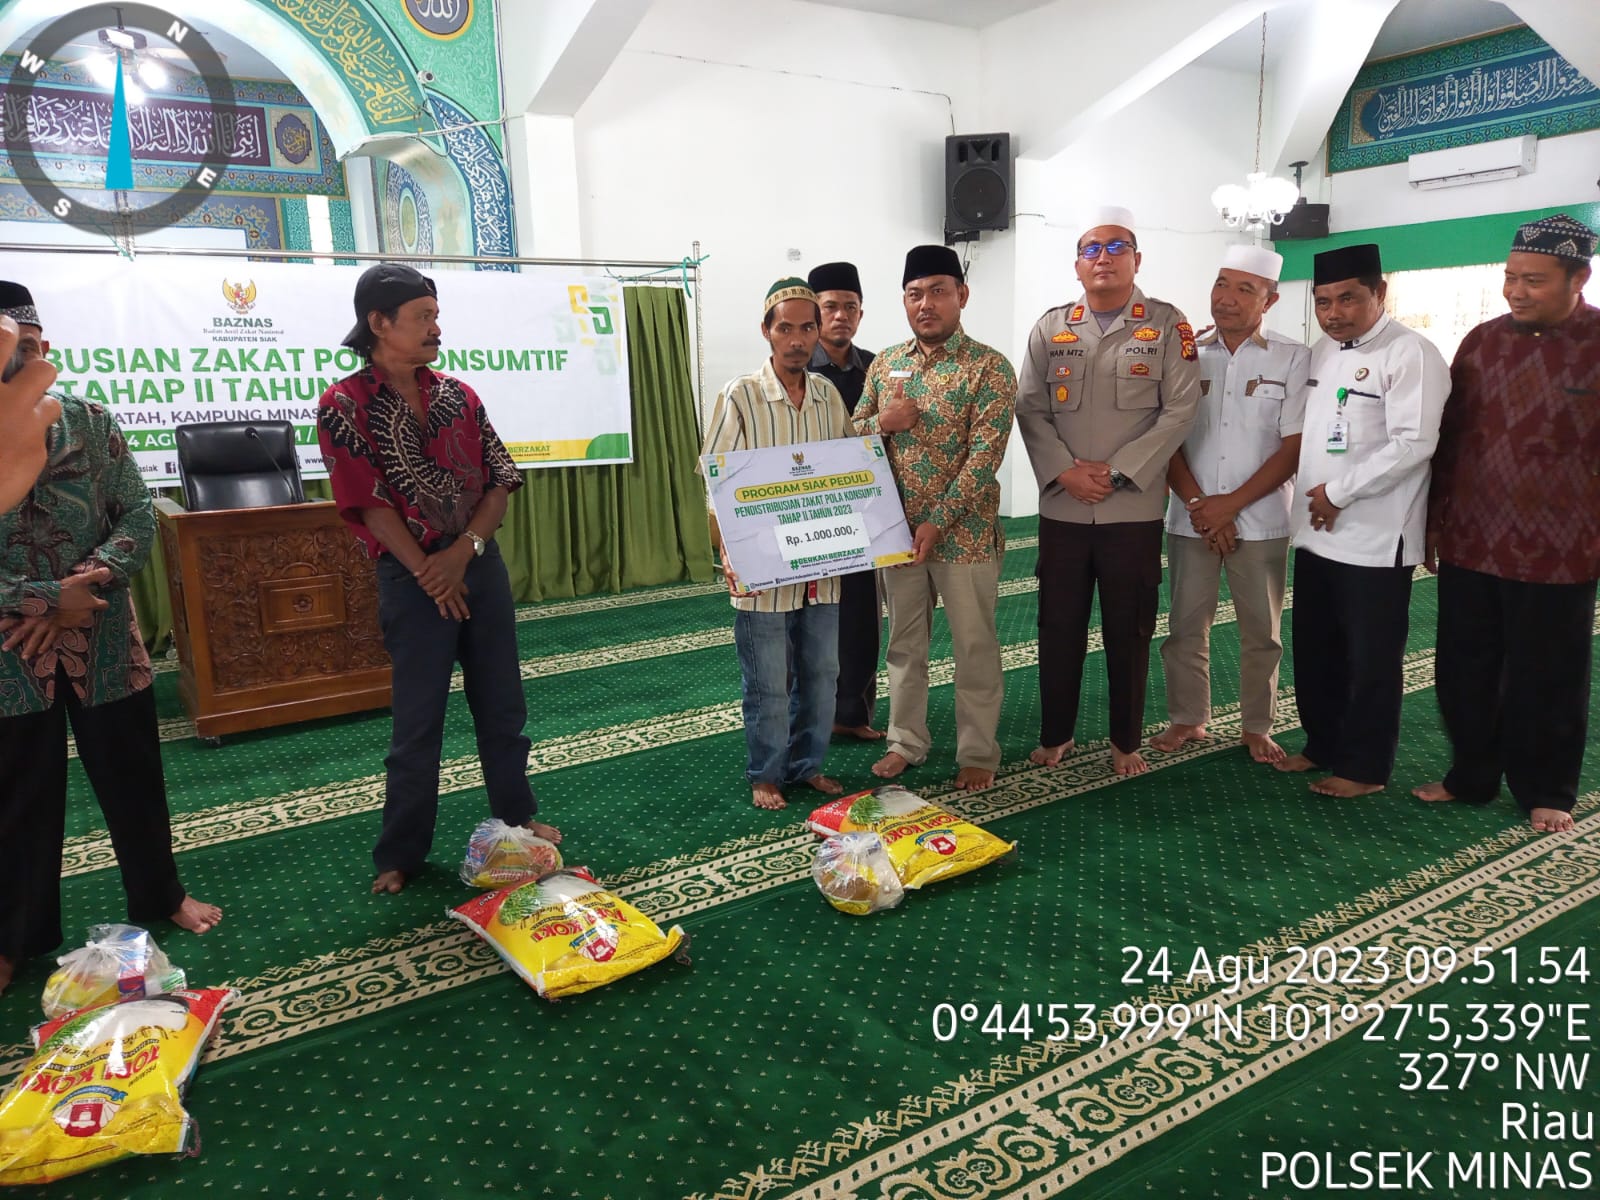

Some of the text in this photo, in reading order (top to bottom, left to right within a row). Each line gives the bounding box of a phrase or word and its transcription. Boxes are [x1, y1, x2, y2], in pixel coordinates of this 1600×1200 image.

[212, 317, 273, 328] BAZNAS
[46, 347, 182, 374] BUSIAN
[190, 347, 305, 373] ZAKAT
[427, 349, 568, 371] ONSUMTIF
[1125, 346, 1158, 356] POLRI
[56, 378, 185, 405] TAHAP
[194, 377, 214, 402] II
[113, 411, 167, 426] ATAH,
[171, 409, 263, 423] KAMPUNG
[508, 444, 551, 453] BERZAKAT
[741, 483, 801, 500] PROGRAM
[801, 479, 829, 492] SIAK
[830, 472, 869, 487] PEDULI
[734, 486, 883, 518] PENDISTRIBUSIAN ZAKAT POLA KONSUMTIF
[777, 511, 801, 525] TAHAP
[809, 507, 833, 520] TAHUN
[834, 504, 853, 516] 2023
[785, 525, 859, 547] Rp. 1.000.000,-
[530, 919, 583, 942] KOKI
